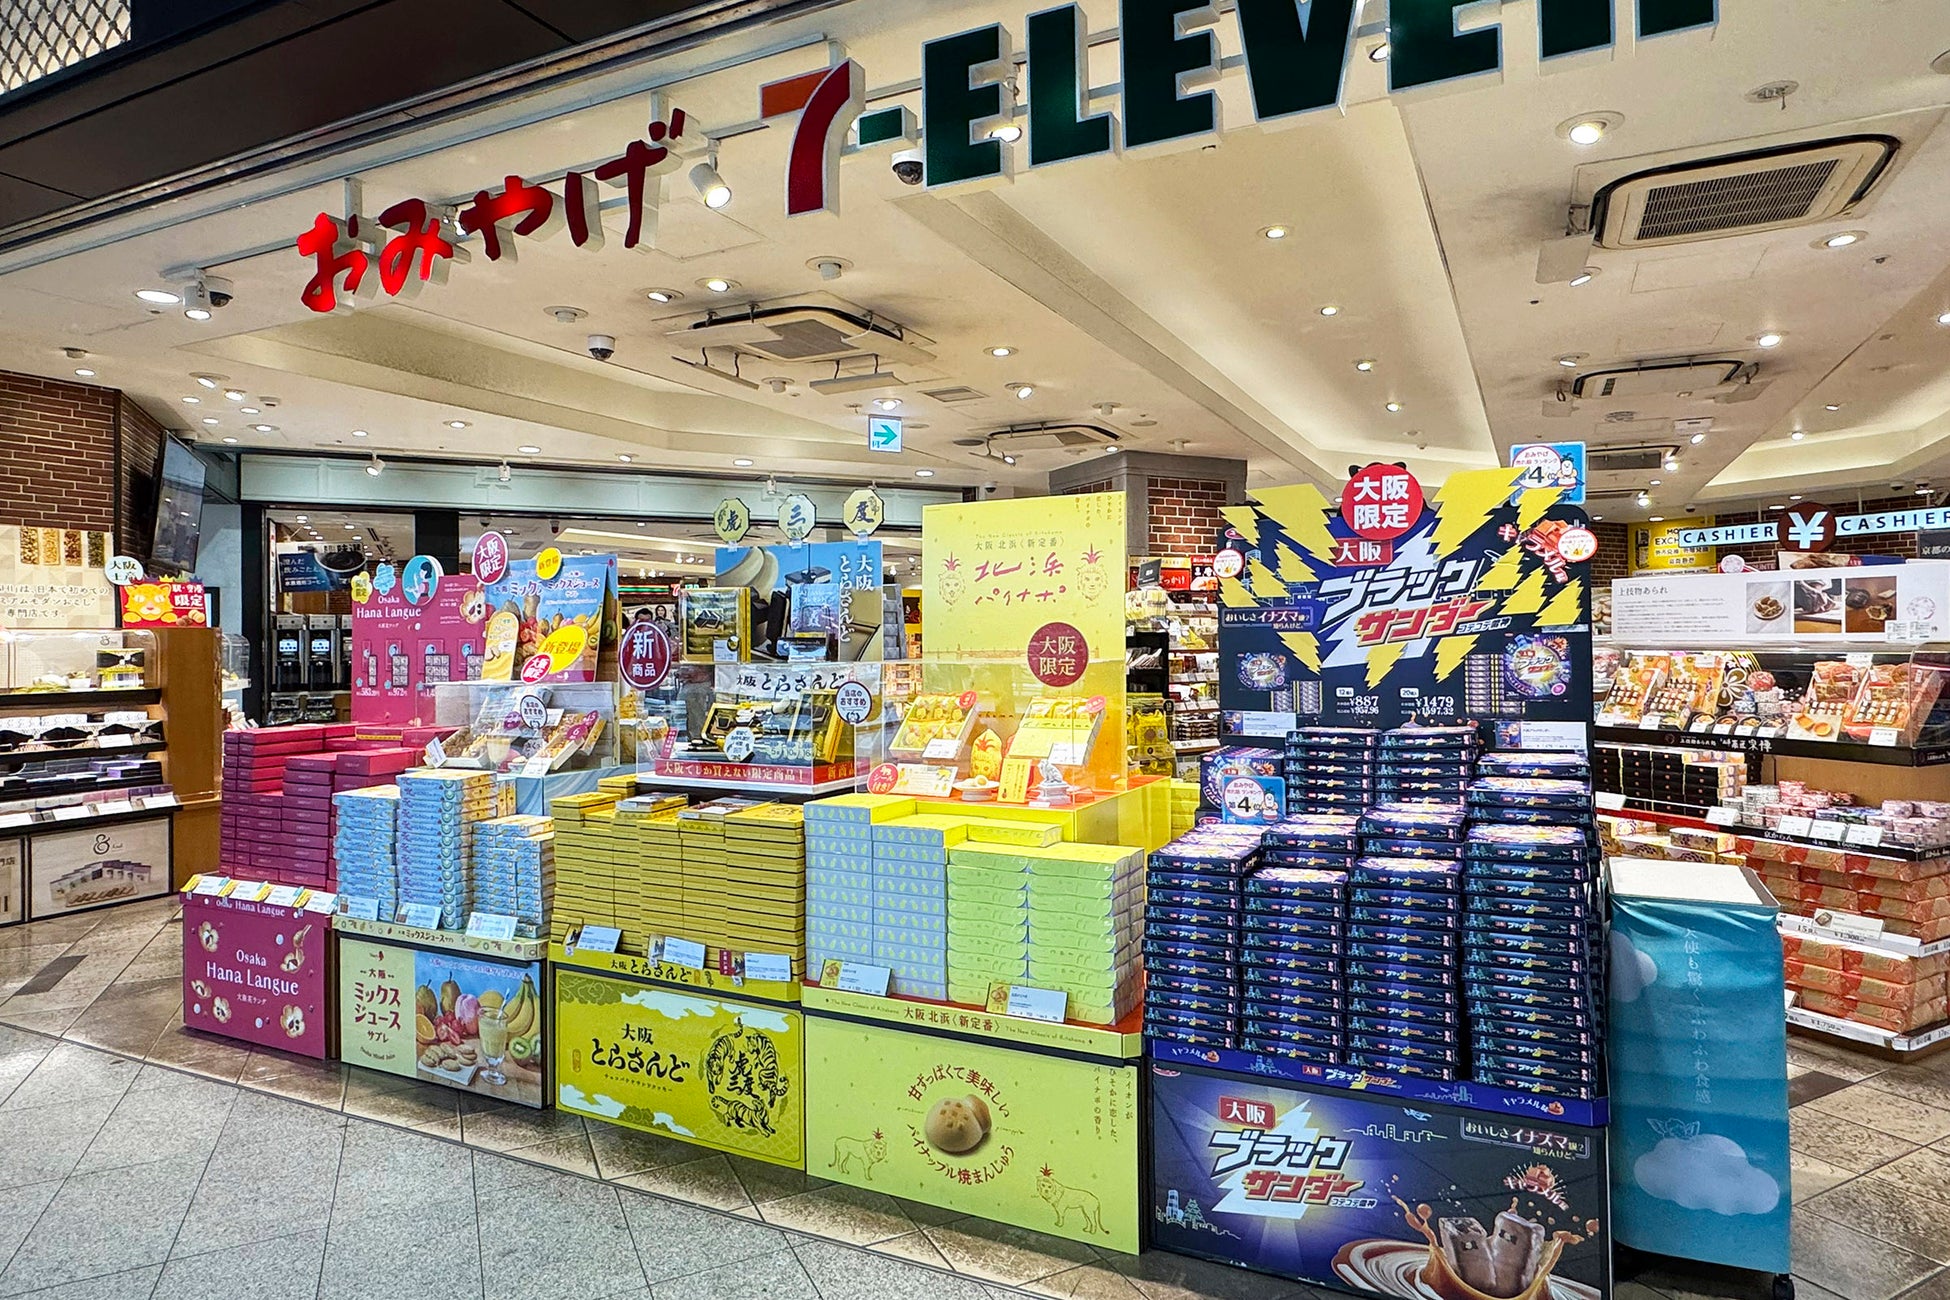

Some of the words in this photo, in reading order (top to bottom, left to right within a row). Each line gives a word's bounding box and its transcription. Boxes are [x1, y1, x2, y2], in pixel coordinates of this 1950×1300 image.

[297, 107, 687, 313] おみやげ
[1353, 474, 1410, 502] 大阪
[722, 509, 743, 532] 虎
[786, 504, 806, 527] 三
[849, 501, 874, 524] 度
[1353, 504, 1409, 530] 限定
[975, 540, 994, 551] 大阪
[1683, 525, 1774, 544] CASHIER
[476, 536, 499, 560] 大阪
[1336, 542, 1383, 563] 大阪
[479, 553, 503, 580] 限定
[855, 554, 874, 592] 大阪
[975, 551, 1064, 582] 北浜
[175, 594, 204, 607] 限定
[377, 595, 400, 604] Osaka
[839, 555, 855, 643] とらさんど
[975, 585, 1067, 606] パイナポ
[1318, 558, 1482, 629] ブラック
[356, 606, 383, 618] Hana
[385, 606, 422, 620] Langue
[1355, 597, 1497, 647] サンダー
[542, 640, 582, 654] 新登場
[633, 630, 655, 660] 新
[1039, 635, 1077, 655] 大阪
[632, 662, 656, 678] 商品
[1039, 657, 1077, 677] 限定
[736, 674, 757, 687] 大阪
[1349, 695, 1379, 706] ¥887
[1415, 696, 1455, 708] ¥1479
[235, 900, 256, 913] Hana
[257, 904, 286, 918] Langue
[405, 929, 446, 943] ミックスジュース
[236, 949, 267, 967] Osaka
[206, 960, 243, 985] Hana
[247, 968, 299, 996] Langue
[368, 968, 387, 980] 大阪
[610, 960, 628, 971] 大阪
[630, 958, 693, 984] とらさんど
[354, 981, 401, 1008] ミックス
[354, 1003, 401, 1032] ジュース
[903, 1006, 926, 1022] 大阪
[367, 1030, 390, 1044] サブレ
[621, 1022, 654, 1046] 大阪
[591, 1037, 691, 1083] とらさんど
[1304, 1066, 1320, 1075] 大阪
[907, 1063, 1011, 1118] 甘ずっぱくて美味しい
[1125, 1071, 1134, 1120] ライオンが
[1225, 1101, 1267, 1126] 大阪
[906, 1123, 1015, 1186] パイナップル焼まんじゅう
[1208, 1128, 1354, 1180] ブラック
[1241, 1169, 1366, 1206] サンダー
